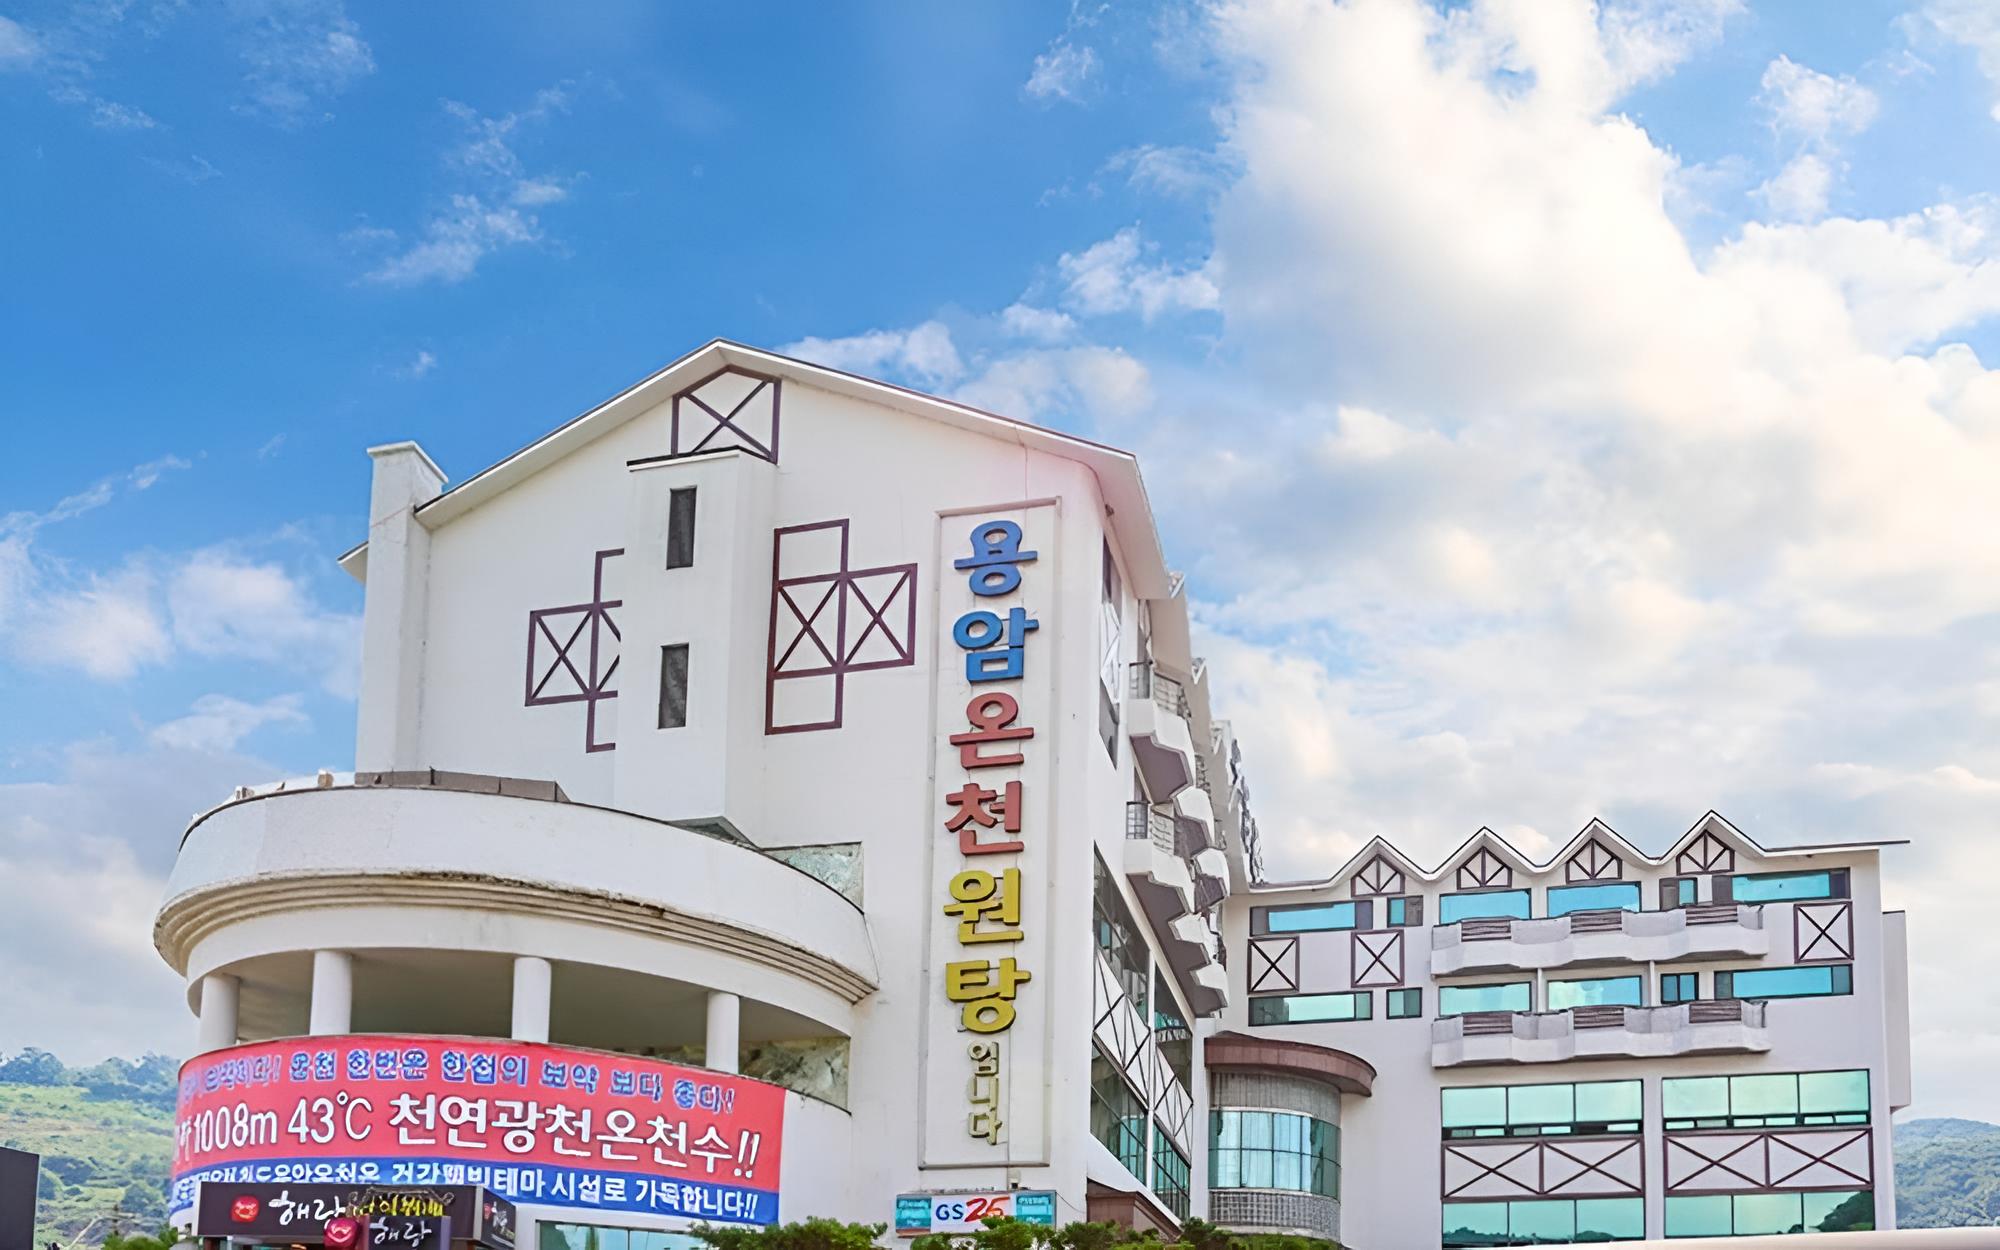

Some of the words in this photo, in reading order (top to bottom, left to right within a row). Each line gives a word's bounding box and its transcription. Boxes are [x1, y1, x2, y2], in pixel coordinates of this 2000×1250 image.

[541, 1060, 600, 1095] 보약
[608, 1069, 664, 1104] 보다
[193, 1102, 278, 1154] 1008m
[388, 1093, 761, 1179] 천연광천온천수!!
[550, 1172, 628, 1204] 시설로
[635, 1179, 759, 1220] 가득합니다!!
